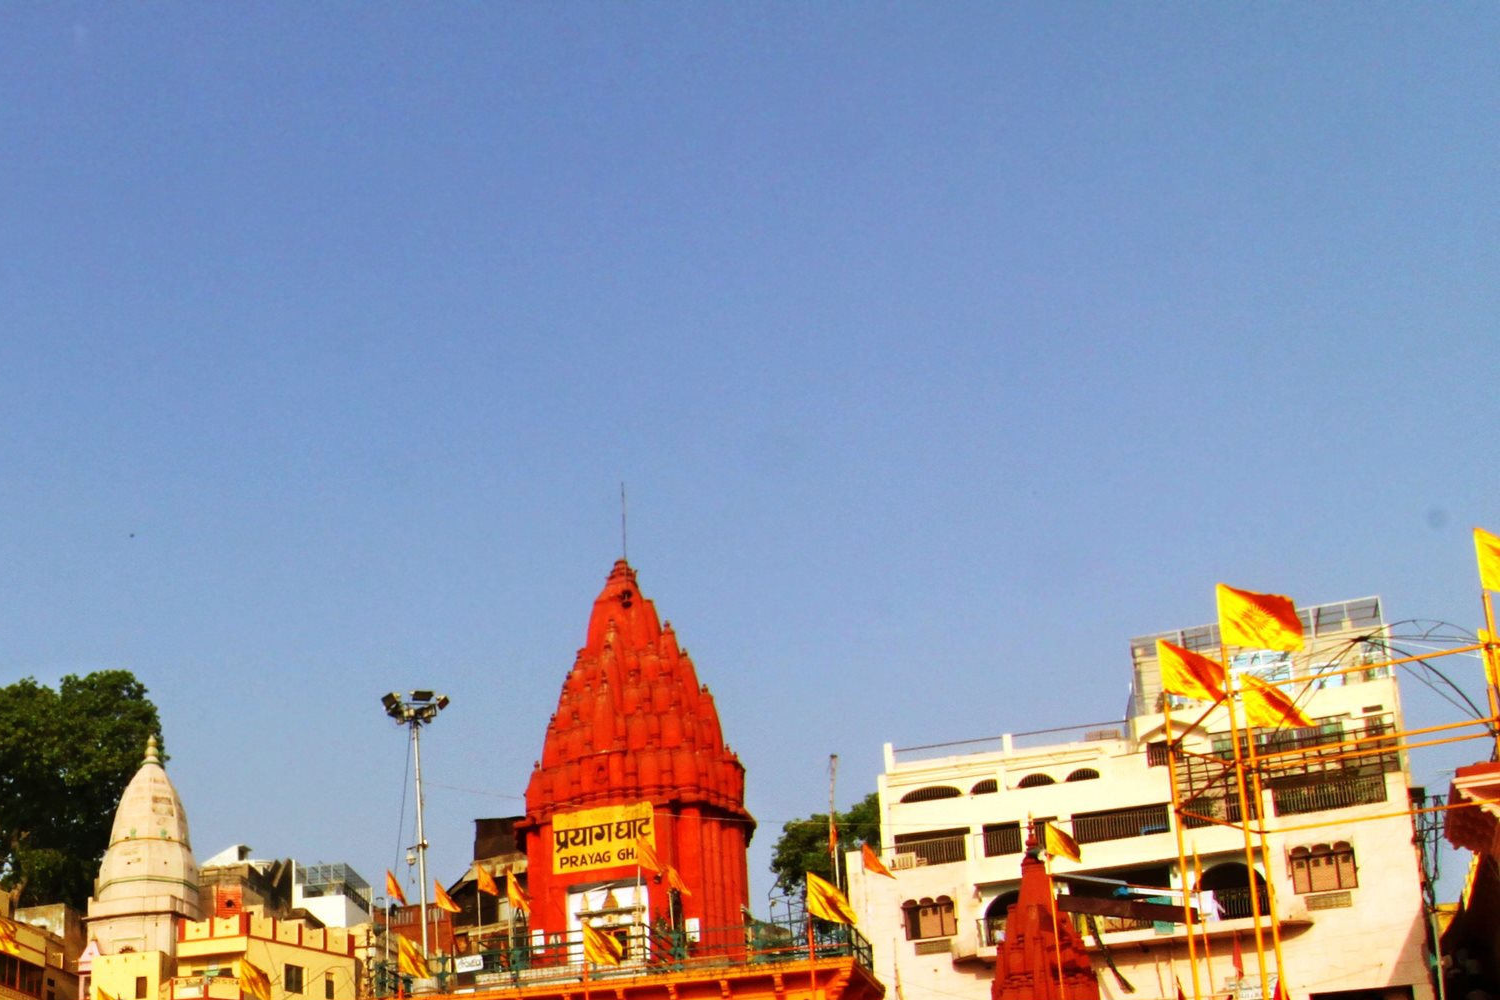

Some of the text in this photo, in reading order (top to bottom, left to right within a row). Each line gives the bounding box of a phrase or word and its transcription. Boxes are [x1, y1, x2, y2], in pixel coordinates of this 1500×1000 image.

[554, 817, 652, 853] प्रयाग घाट
[560, 848, 638, 869] PRAYAG GH
